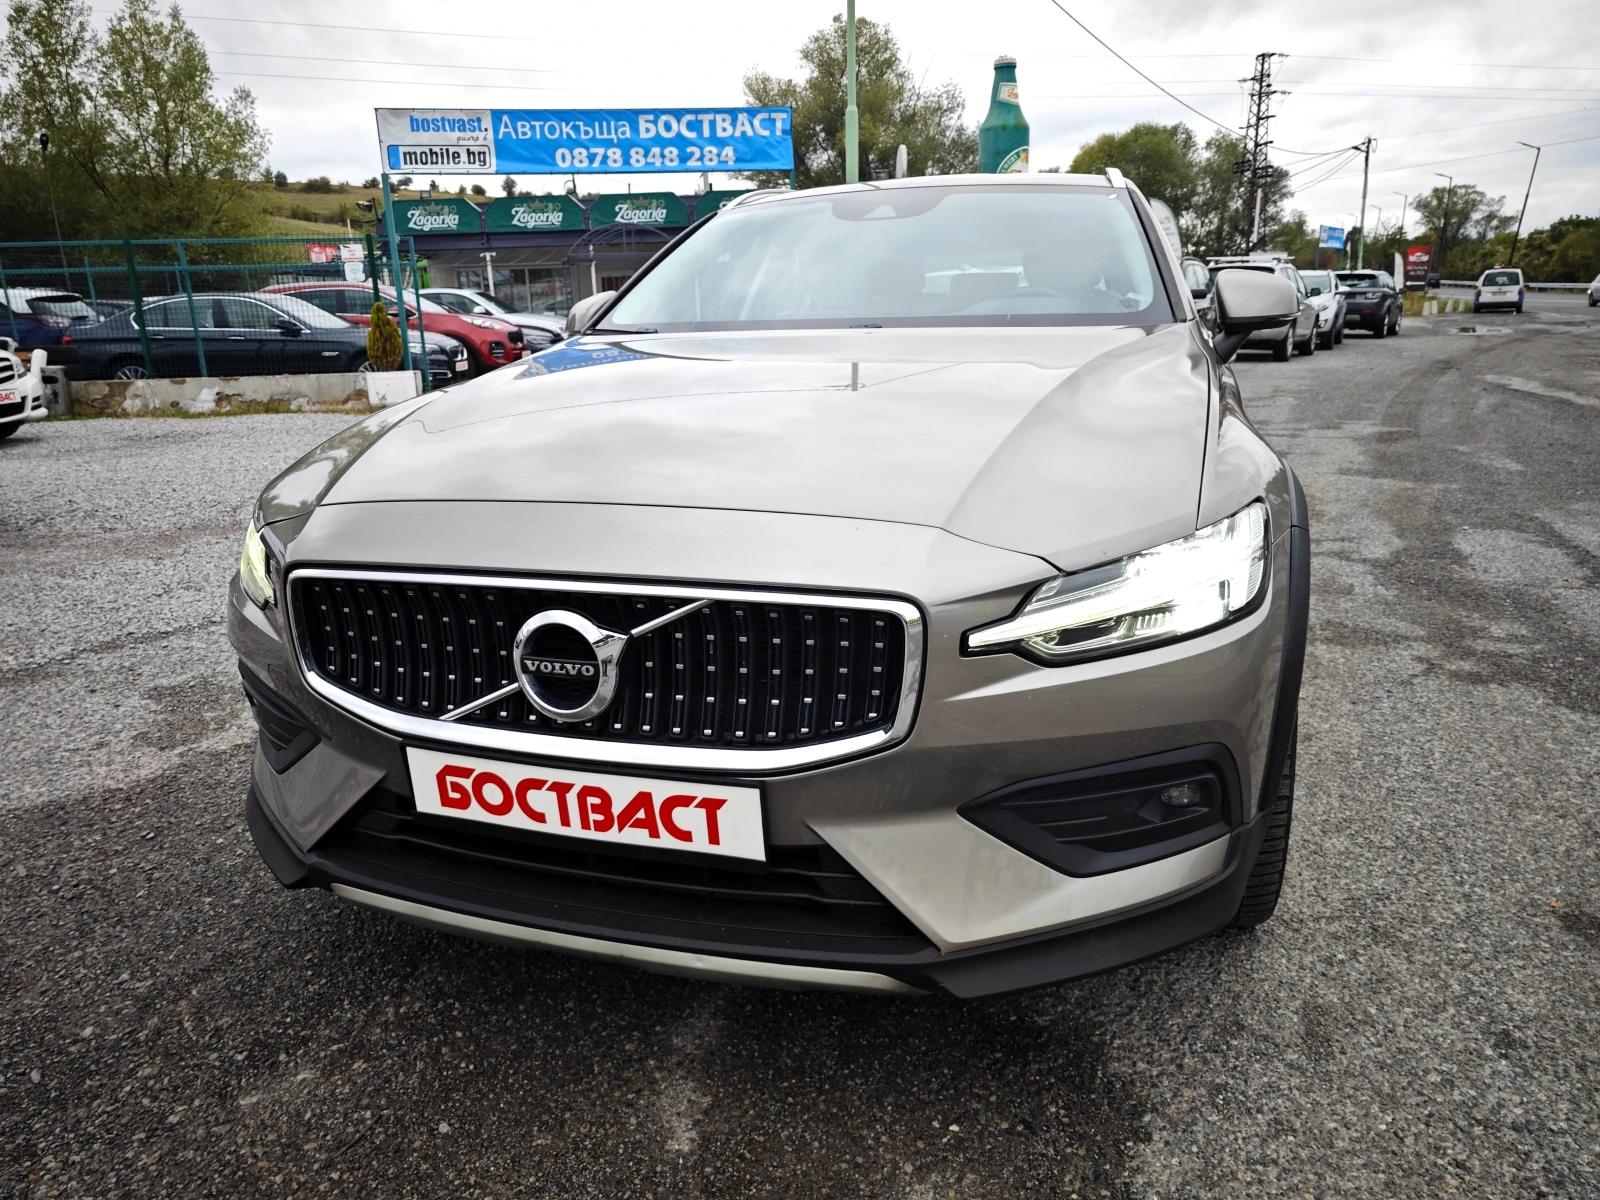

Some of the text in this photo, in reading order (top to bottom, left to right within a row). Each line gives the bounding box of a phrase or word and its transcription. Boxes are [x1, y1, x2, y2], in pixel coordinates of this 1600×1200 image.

[498, 112, 788, 144] Автокъща БОСТВАСТ
[402, 147, 487, 167] mobile.bg
[555, 146, 737, 168] 0878 848 284
[407, 210, 460, 232] Zagorka
[511, 207, 564, 229] Zagorka
[614, 204, 667, 225] Zagorka
[524, 660, 595, 677] VOLVO
[436, 764, 728, 846] БОСТВАСТ
